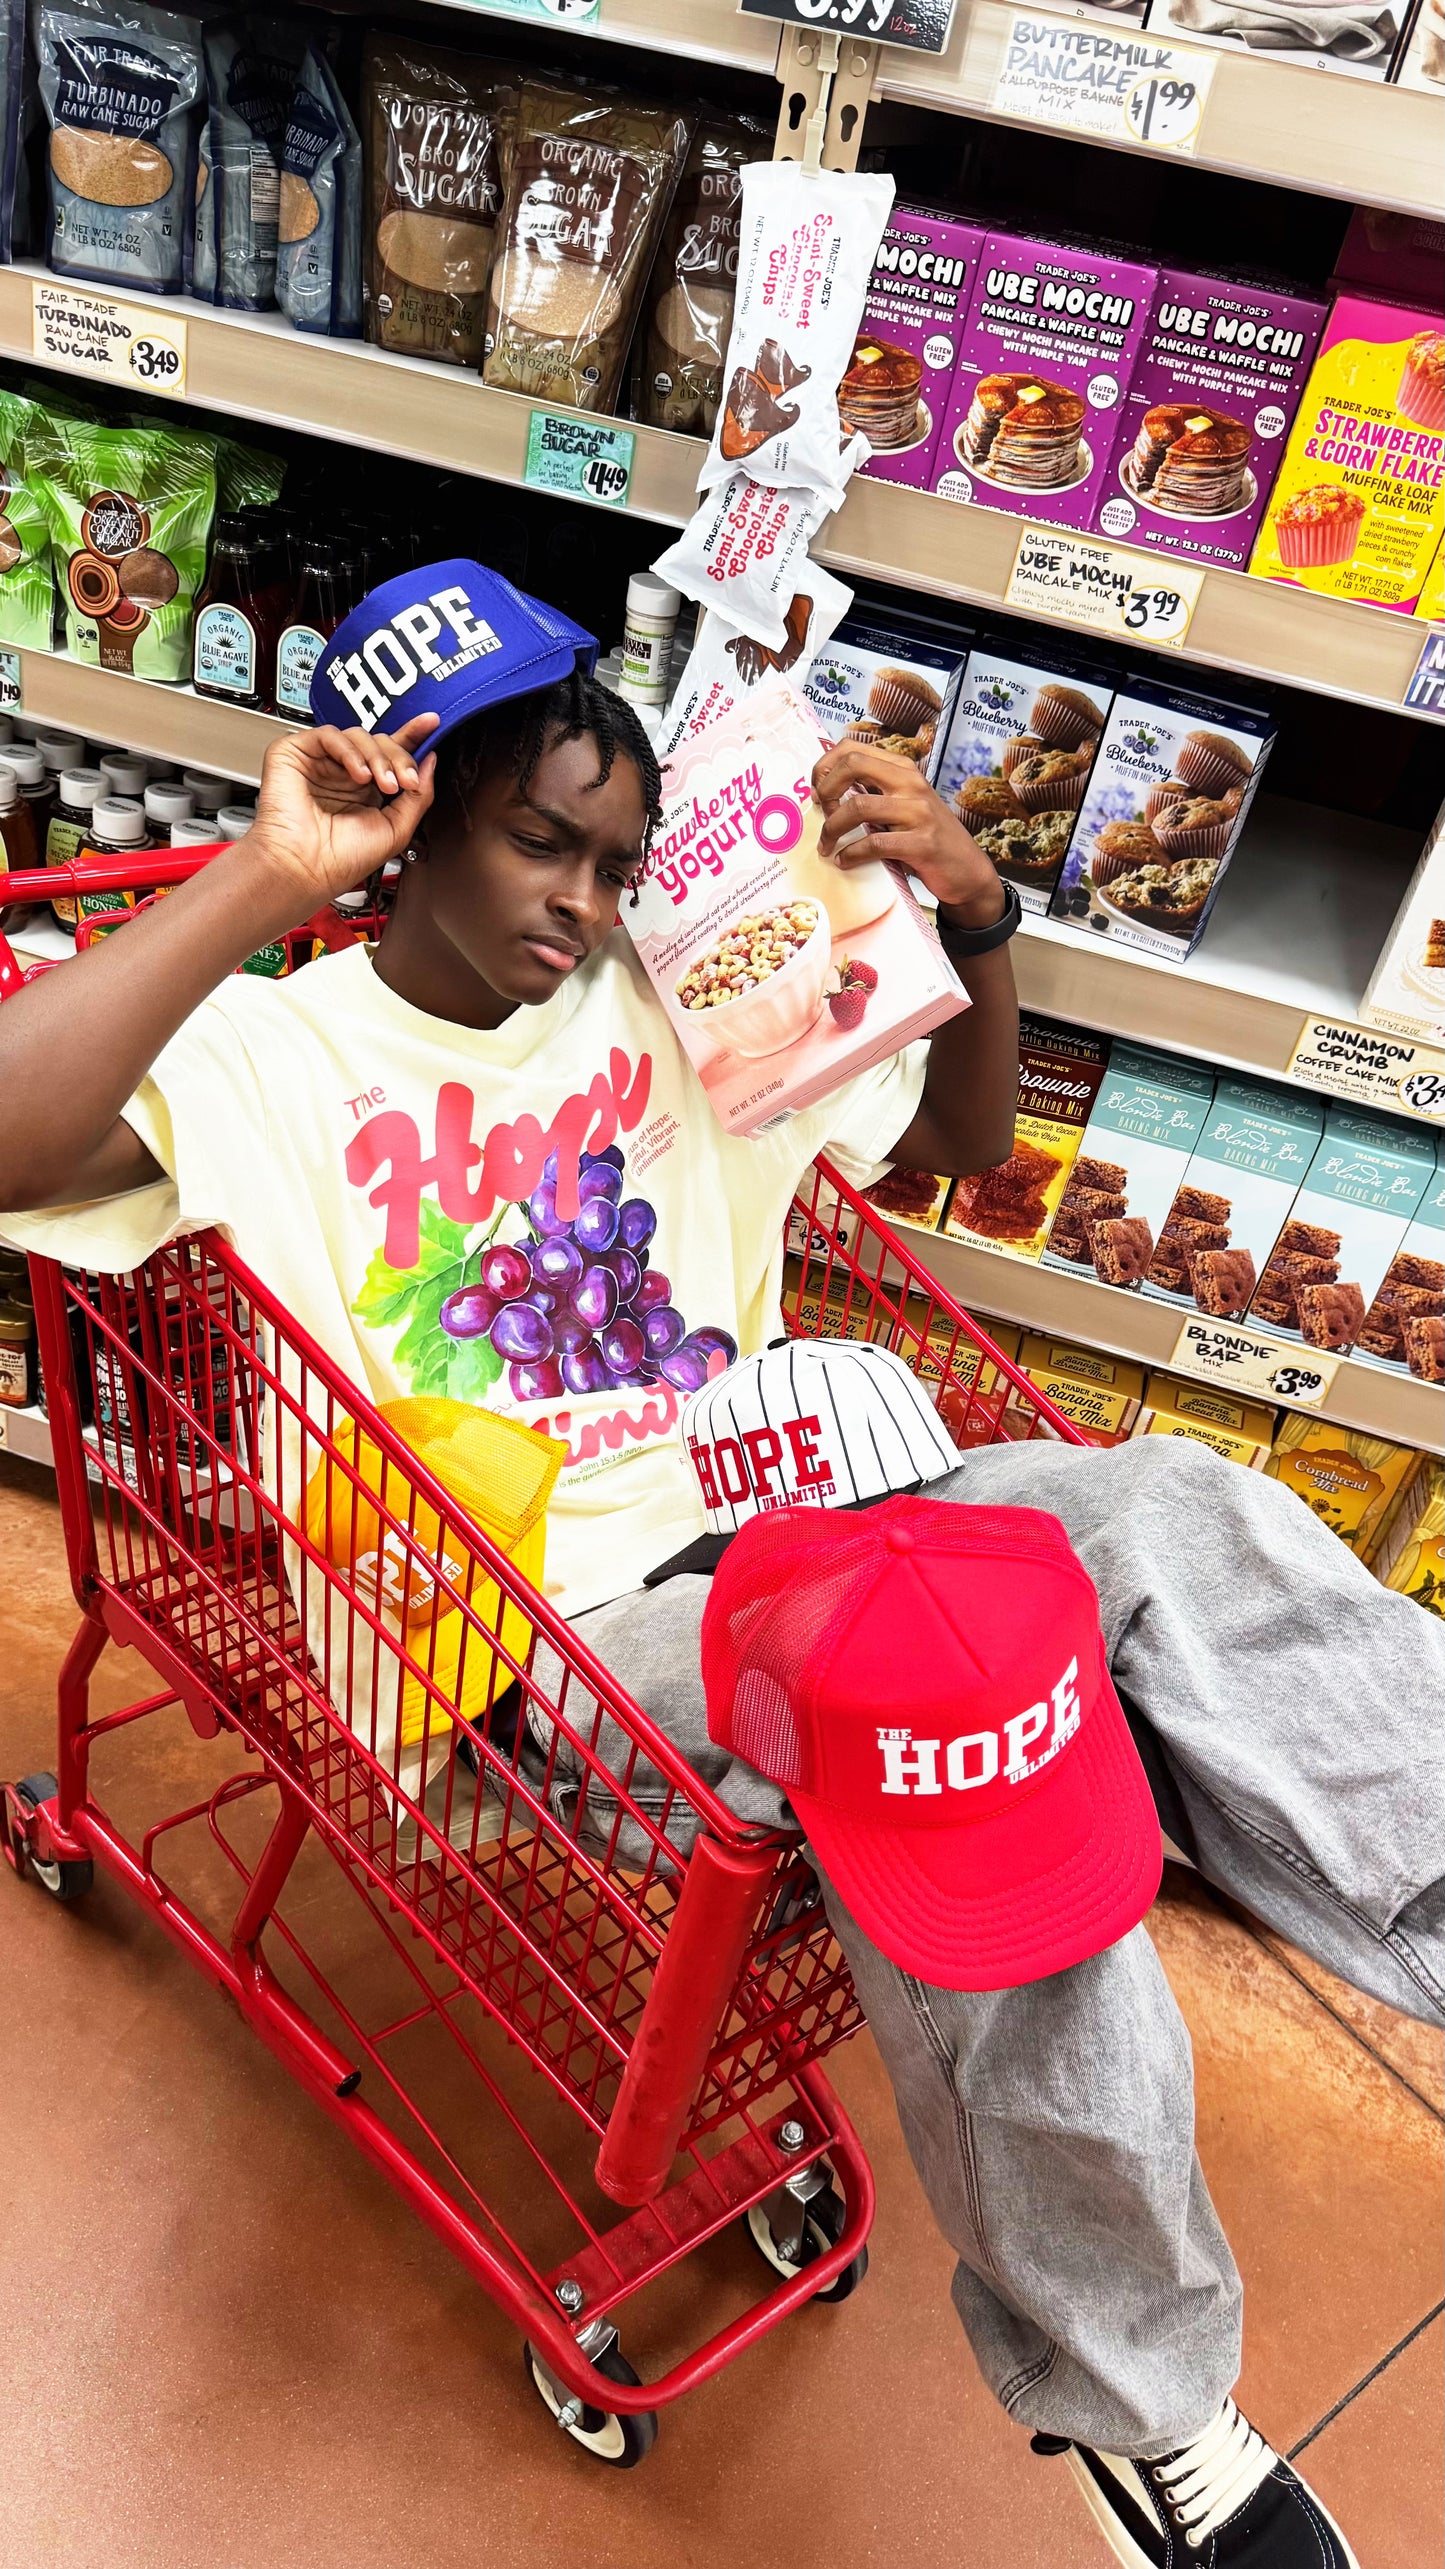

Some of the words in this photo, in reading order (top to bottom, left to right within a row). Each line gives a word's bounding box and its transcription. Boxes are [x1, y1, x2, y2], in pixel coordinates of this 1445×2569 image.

[1012, 20, 1173, 70] BUTTERMILK
[1006, 46, 1139, 94] PANCAKE
[67, 80, 162, 114] TURBINADO
[1038, 94, 1076, 111] MIX
[61, 101, 89, 119] RAW
[92, 107, 119, 125] CANE
[122, 113, 159, 129] SUGAR
[541, 141, 625, 179] ORGANIC
[395, 152, 498, 213] SUGAR
[72, 223, 89, 234] NET
[113, 231, 124, 242] 24
[127, 234, 141, 245] OZ
[902, 231, 931, 246] JOE'S
[876, 245, 966, 287] MOCHI
[1035, 262, 1070, 281] TRADER
[1071, 269, 1101, 286] JOE'S
[41, 290, 69, 303] FAIR
[73, 298, 118, 315] TRADE
[873, 281, 882, 291] &
[882, 279, 929, 302] WAFFLE
[932, 290, 958, 308] MIX
[986, 268, 1039, 301] UBE
[1042, 281, 1136, 327] MOCHI
[35, 305, 132, 338] TURBINADO
[866, 307, 900, 325] PURPLE
[902, 315, 922, 329] YAM
[889, 298, 932, 320] PANCAKE
[934, 309, 954, 323] MIX
[981, 302, 1038, 329] PANCAKE
[1038, 316, 1048, 328] &
[1048, 316, 1098, 341] WAFFLE
[1099, 329, 1125, 347] MIX
[45, 324, 73, 338] RAW
[76, 331, 109, 347] CANE
[976, 321, 985, 332] A
[987, 324, 1021, 342] CHEWY
[1022, 332, 1053, 348] MOCHI
[1053, 339, 1098, 360] PANCAKE
[1100, 350, 1121, 364] MIX
[1158, 303, 1210, 337] UBE
[1213, 315, 1304, 359] MOCHI
[44, 337, 113, 362] SUGAR
[129, 341, 179, 379] $3.49
[926, 343, 952, 357] GLUTEN
[928, 352, 947, 364] FREE
[1003, 339, 1028, 354] WITH
[1029, 346, 1065, 365] PURPLE
[1066, 354, 1088, 369] YAM
[1146, 353, 1155, 364] A
[1157, 356, 1190, 374] CHEWY
[1191, 363, 1222, 381] MOCHI
[1223, 371, 1268, 391] PANCAKE
[1269, 381, 1289, 394] MIX
[1172, 371, 1197, 385] WITH
[1198, 378, 1234, 396] PURPLE
[1235, 386, 1257, 400] YAM
[1090, 382, 1118, 396] GLUTEN
[1092, 390, 1111, 403] FREE
[545, 417, 616, 445] BROWN
[541, 433, 604, 459] SUGAR
[1304, 440, 1319, 459] &
[1320, 438, 1379, 475] CORN
[1379, 452, 1445, 488] FLAKE
[1342, 470, 1391, 494] MUFFIN
[1393, 483, 1404, 495] &
[1405, 484, 1439, 503] LOAF
[1372, 492, 1405, 509] CAKE
[1406, 498, 1435, 516] MIX
[727, 486, 779, 580] Chocolate
[755, 503, 790, 561] Chips
[1364, 528, 1383, 541] dried
[1383, 533, 1420, 550] strawberry
[1370, 519, 1385, 530] with
[1385, 522, 1424, 539] sweetened
[1025, 533, 1075, 554] GLUTEN
[1080, 548, 1113, 563] FREE
[1358, 539, 1381, 553] pieces
[1381, 543, 1388, 552] &
[1389, 545, 1416, 562] crunchy
[1016, 568, 1083, 591] PANCAKE
[1087, 585, 1113, 600] MIX
[1019, 549, 1062, 572] UBE
[1069, 561, 1133, 592] MOCHI
[207, 623, 246, 643] ORGANIC
[202, 642, 222, 658] BLUE
[222, 651, 249, 664] AGAVE
[332, 585, 497, 733] HOPE
[431, 635, 503, 682] UNLIMITED
[282, 664, 301, 679] BLUE
[326, 655, 346, 681] THE
[974, 675, 1004, 688] TRADER
[1004, 679, 1028, 696] JOE'S
[962, 700, 1029, 736] Blueberry
[971, 719, 996, 736] MUFFIN
[996, 727, 1009, 739] MIX
[1313, 1024, 1416, 1063] CINNAMON
[1316, 1041, 1389, 1070] CRUMB
[1296, 1053, 1343, 1073] COFFEE
[1345, 1066, 1377, 1081] CAKE
[1378, 1075, 1401, 1088] MIX
[343, 1085, 387, 1121] The
[729, 1105, 740, 1117] NET
[750, 1094, 757, 1104] 12
[757, 1089, 766, 1099] OZ
[1029, 1092, 1063, 1115] Baking
[1066, 1100, 1084, 1117] Mix
[638, 1131, 647, 1144] of
[645, 1111, 673, 1136] Hope:
[647, 1120, 681, 1149] Vibrant,
[1118, 1116, 1149, 1134] BAKING
[1153, 1126, 1169, 1140] MIX
[1208, 1122, 1270, 1154] Blondie
[344, 1046, 652, 1270] Hope
[1186, 1324, 1278, 1360] BLONDIE
[1195, 1342, 1245, 1364] BAR
[1054, 1359, 1085, 1374] Bread
[1087, 1368, 1109, 1380] Mix
[1202, 1356, 1224, 1369] MIX
[1042, 1383, 1104, 1411] Banana
[1061, 1382, 1090, 1396] TRADER
[1092, 1390, 1114, 1403] JOE'S
[1079, 1409, 1113, 1428] Mix
[579, 1460, 599, 1474] John
[689, 1414, 834, 1510] HOPE
[1294, 1459, 1369, 1492] Cornbread
[761, 1480, 837, 1511] UNLIMITED
[1309, 1477, 1339, 1494] Mix
[876, 1727, 912, 1741] THE
[877, 1654, 1082, 1796] HOPE
[1008, 1713, 1082, 1785] UNLIMITED
